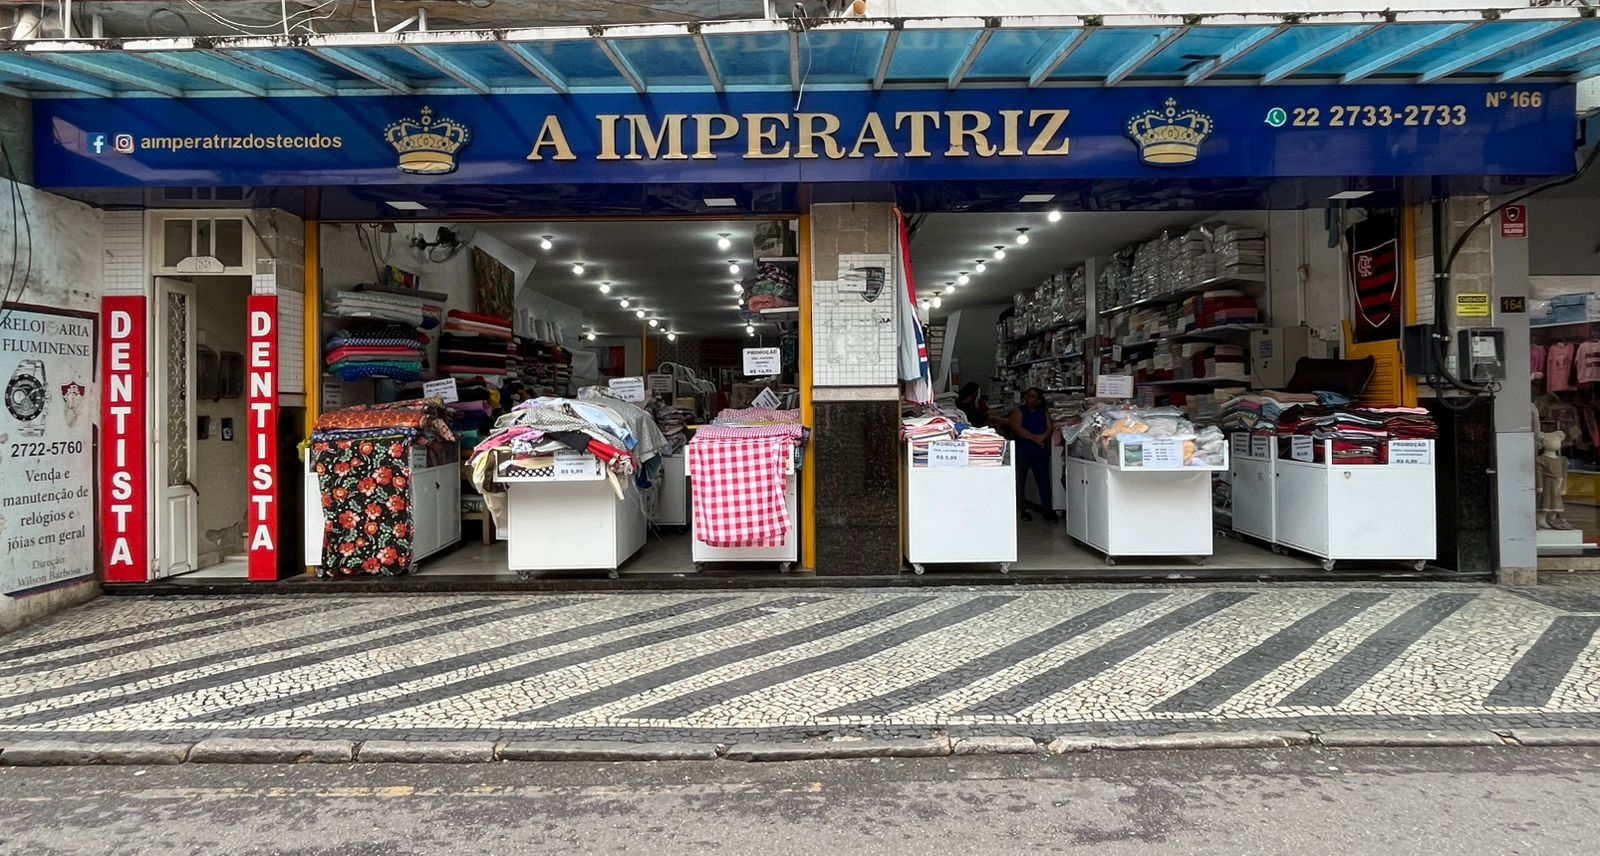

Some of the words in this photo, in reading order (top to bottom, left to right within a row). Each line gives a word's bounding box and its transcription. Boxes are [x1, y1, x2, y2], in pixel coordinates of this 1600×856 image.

[1510, 92, 1542, 108] 166
[1292, 107, 1320, 126] 22
[1329, 105, 1468, 126] 2733-2733
[526, 114, 577, 160] A
[596, 109, 1071, 160] IMPERATRIZ
[1503, 299, 1523, 311] 164
[3, 338, 90, 356] FLUMINENSE
[110, 310, 134, 566] DENTISTA
[250, 311, 274, 551] DENTISTA
[11, 440, 83, 457] 2722-5760
[26, 467, 61, 482] Venda
[64, 470, 70, 479] e
[3, 488, 74, 507] manutenção
[76, 485, 89, 498] de
[20, 510, 66, 527] relógios
[68, 510, 75, 519] e
[7, 536, 35, 555] jóias
[38, 533, 56, 545] em
[59, 525, 85, 545] geral
[17, 575, 47, 586] Wilson
